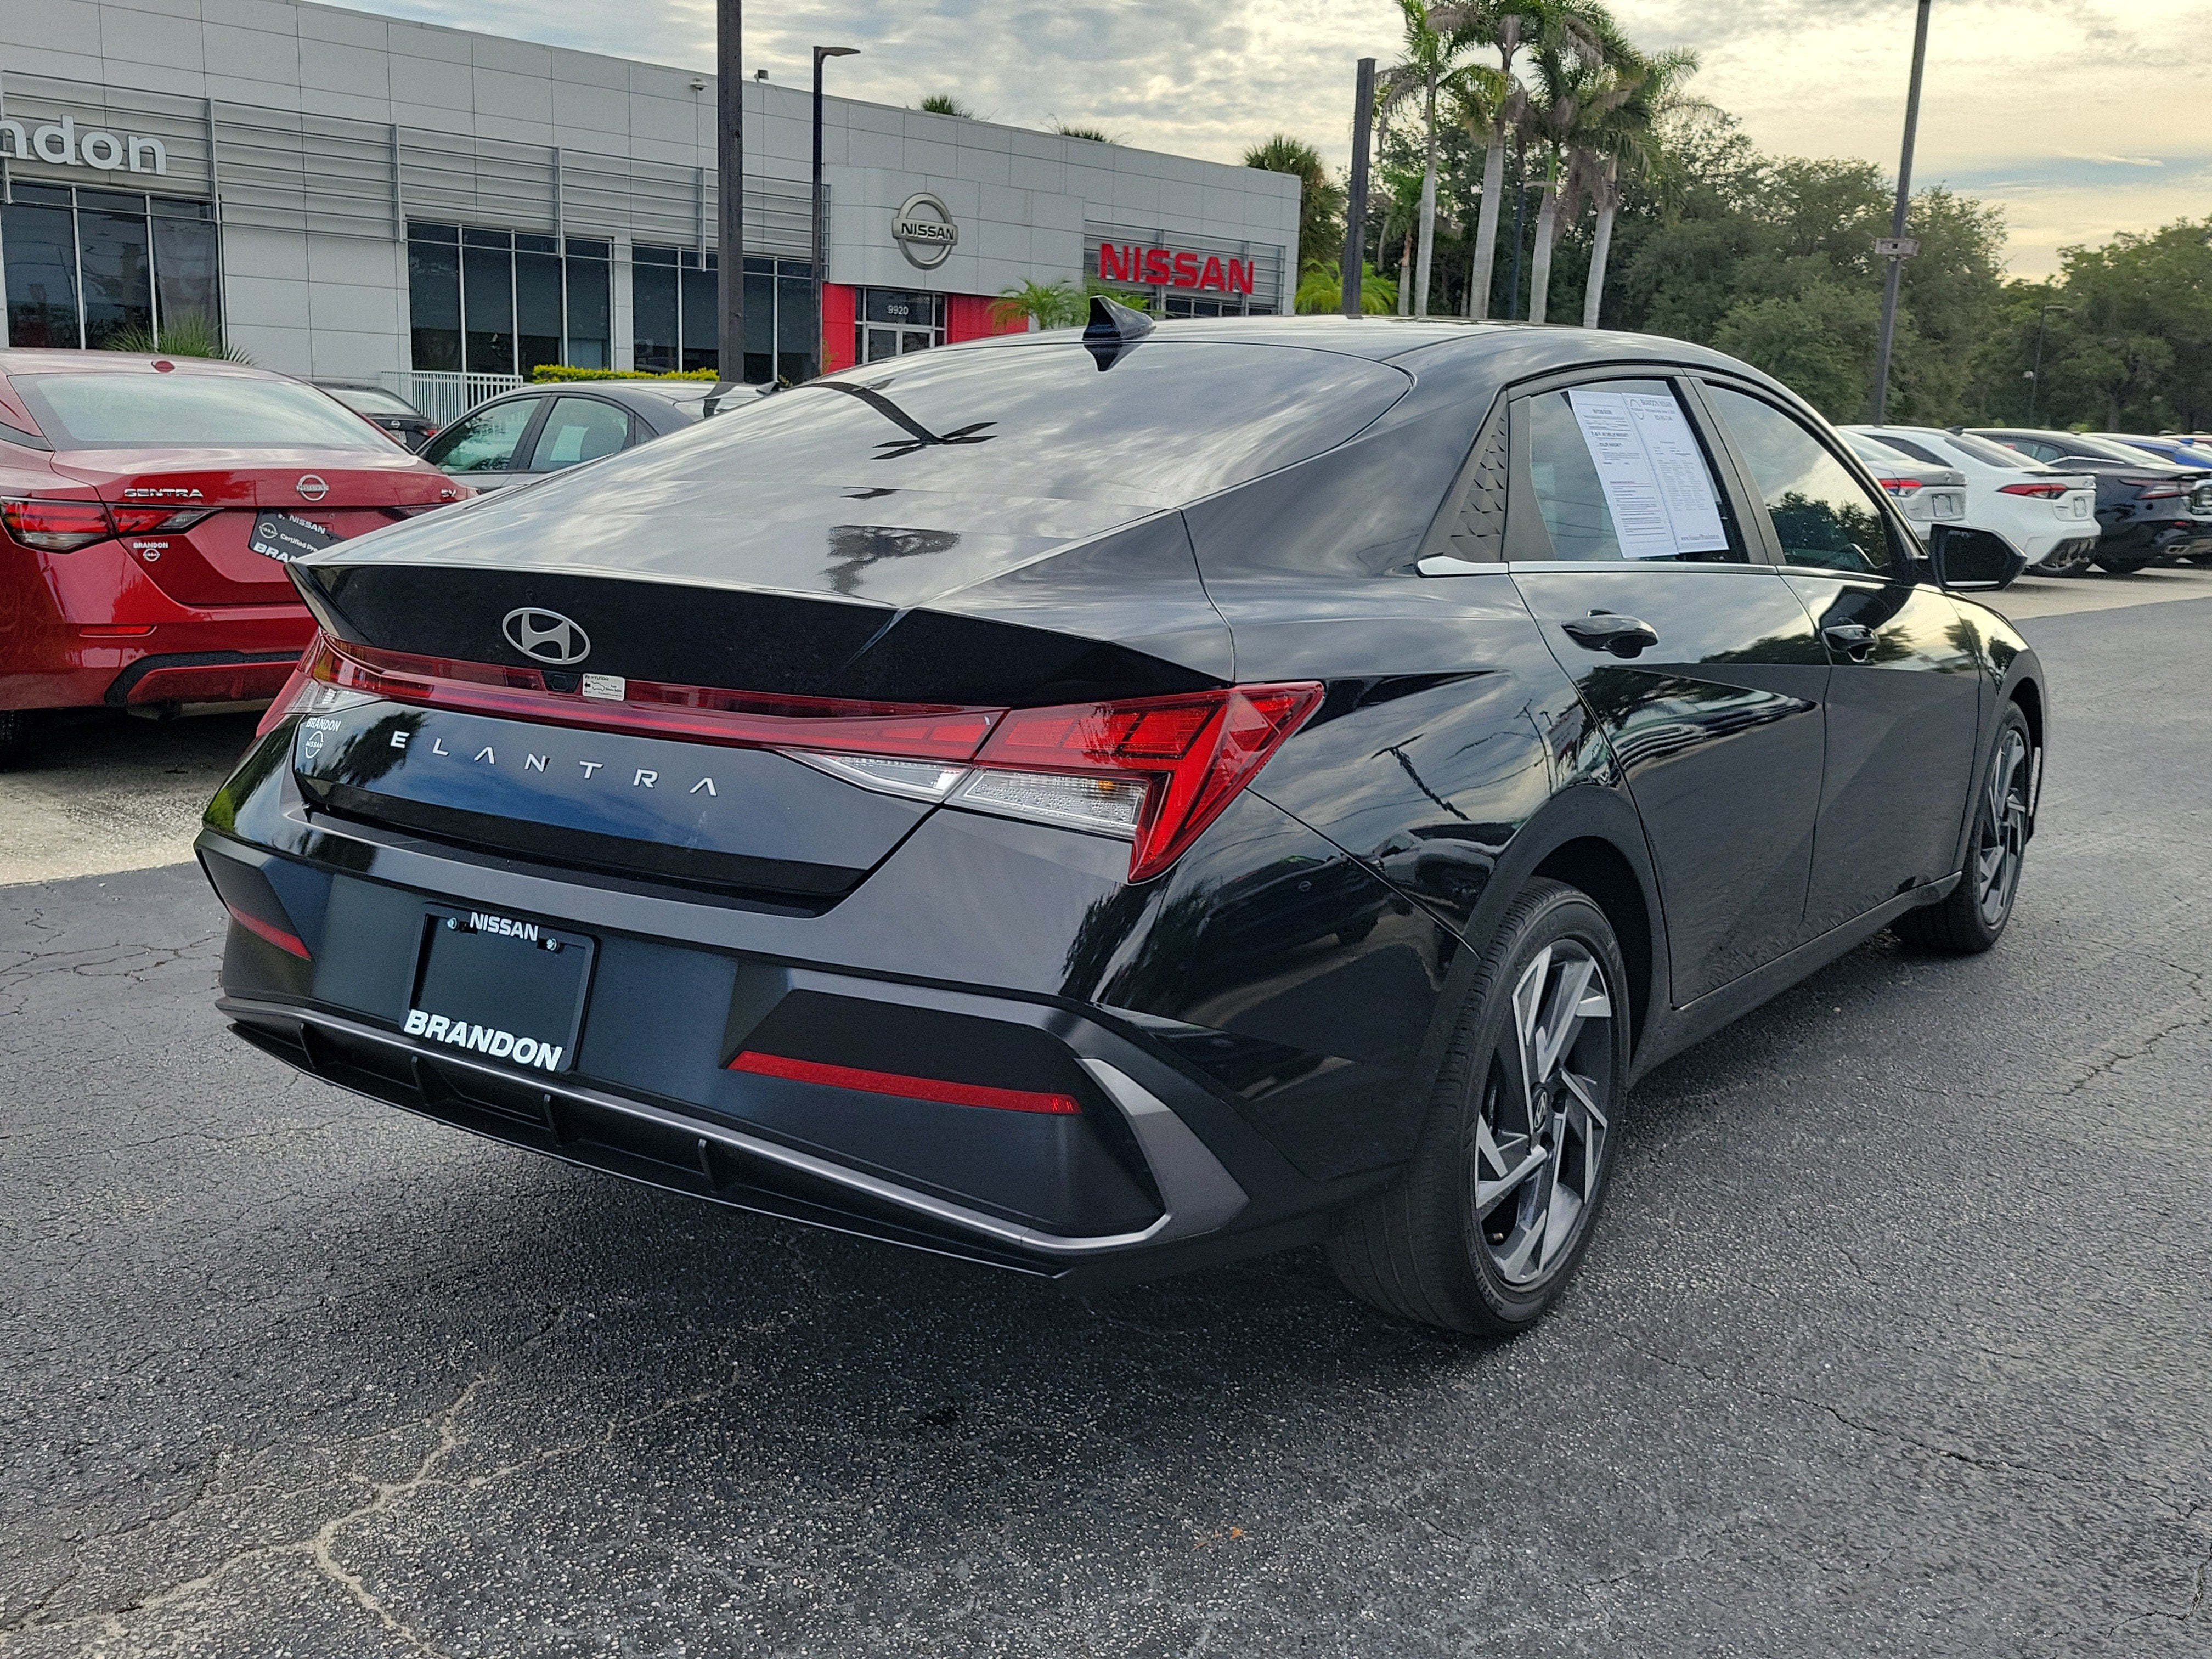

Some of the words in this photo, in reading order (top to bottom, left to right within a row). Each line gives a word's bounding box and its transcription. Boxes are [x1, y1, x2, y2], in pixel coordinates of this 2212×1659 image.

[901, 223, 954, 240] NISSAN
[1099, 243, 1254, 295] NISSAN
[887, 305, 909, 315] 9920
[124, 488, 204, 498] SENTRA
[441, 489, 456, 497] SV
[289, 514, 326, 535] NISSAN
[280, 533, 307, 549] Certified
[306, 717, 341, 732] BRANDON
[306, 741, 324, 749] NISSAN
[390, 730, 717, 797] ELANTRA
[470, 912, 539, 942] NISSAN
[404, 1009, 563, 1071] BRANDON
